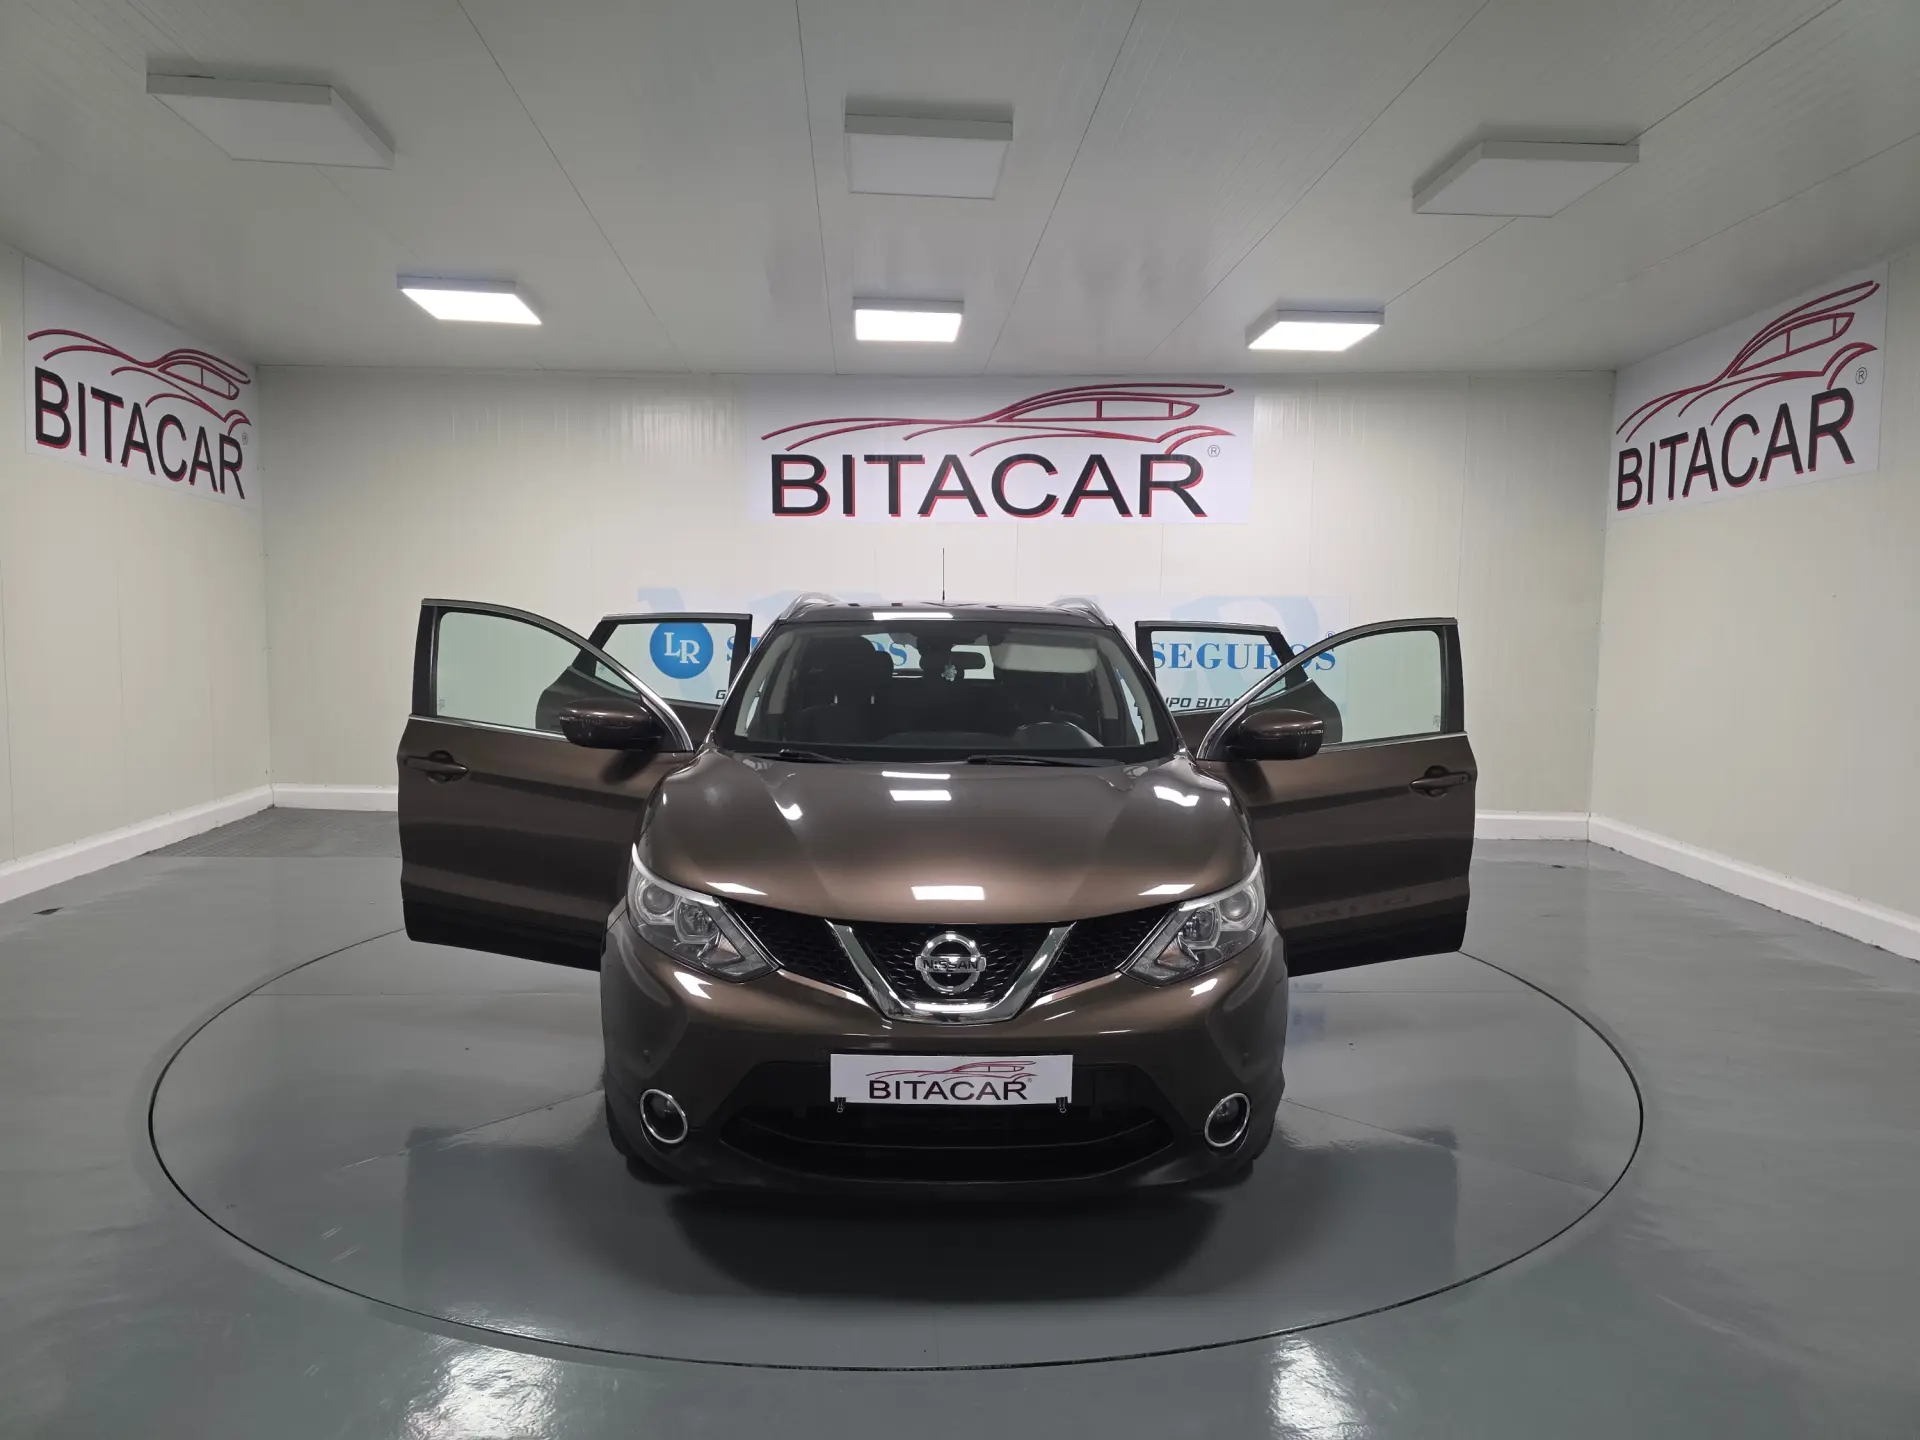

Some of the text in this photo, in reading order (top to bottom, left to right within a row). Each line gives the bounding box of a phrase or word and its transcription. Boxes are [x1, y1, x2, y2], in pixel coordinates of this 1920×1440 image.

[35, 366, 245, 500] BITACAR
[1617, 388, 1855, 511] BITACAR
[771, 454, 1208, 517] BITACAR
[664, 632, 700, 664] LR
[924, 959, 979, 970] NISSAN
[869, 1080, 1028, 1100] BITACAR
